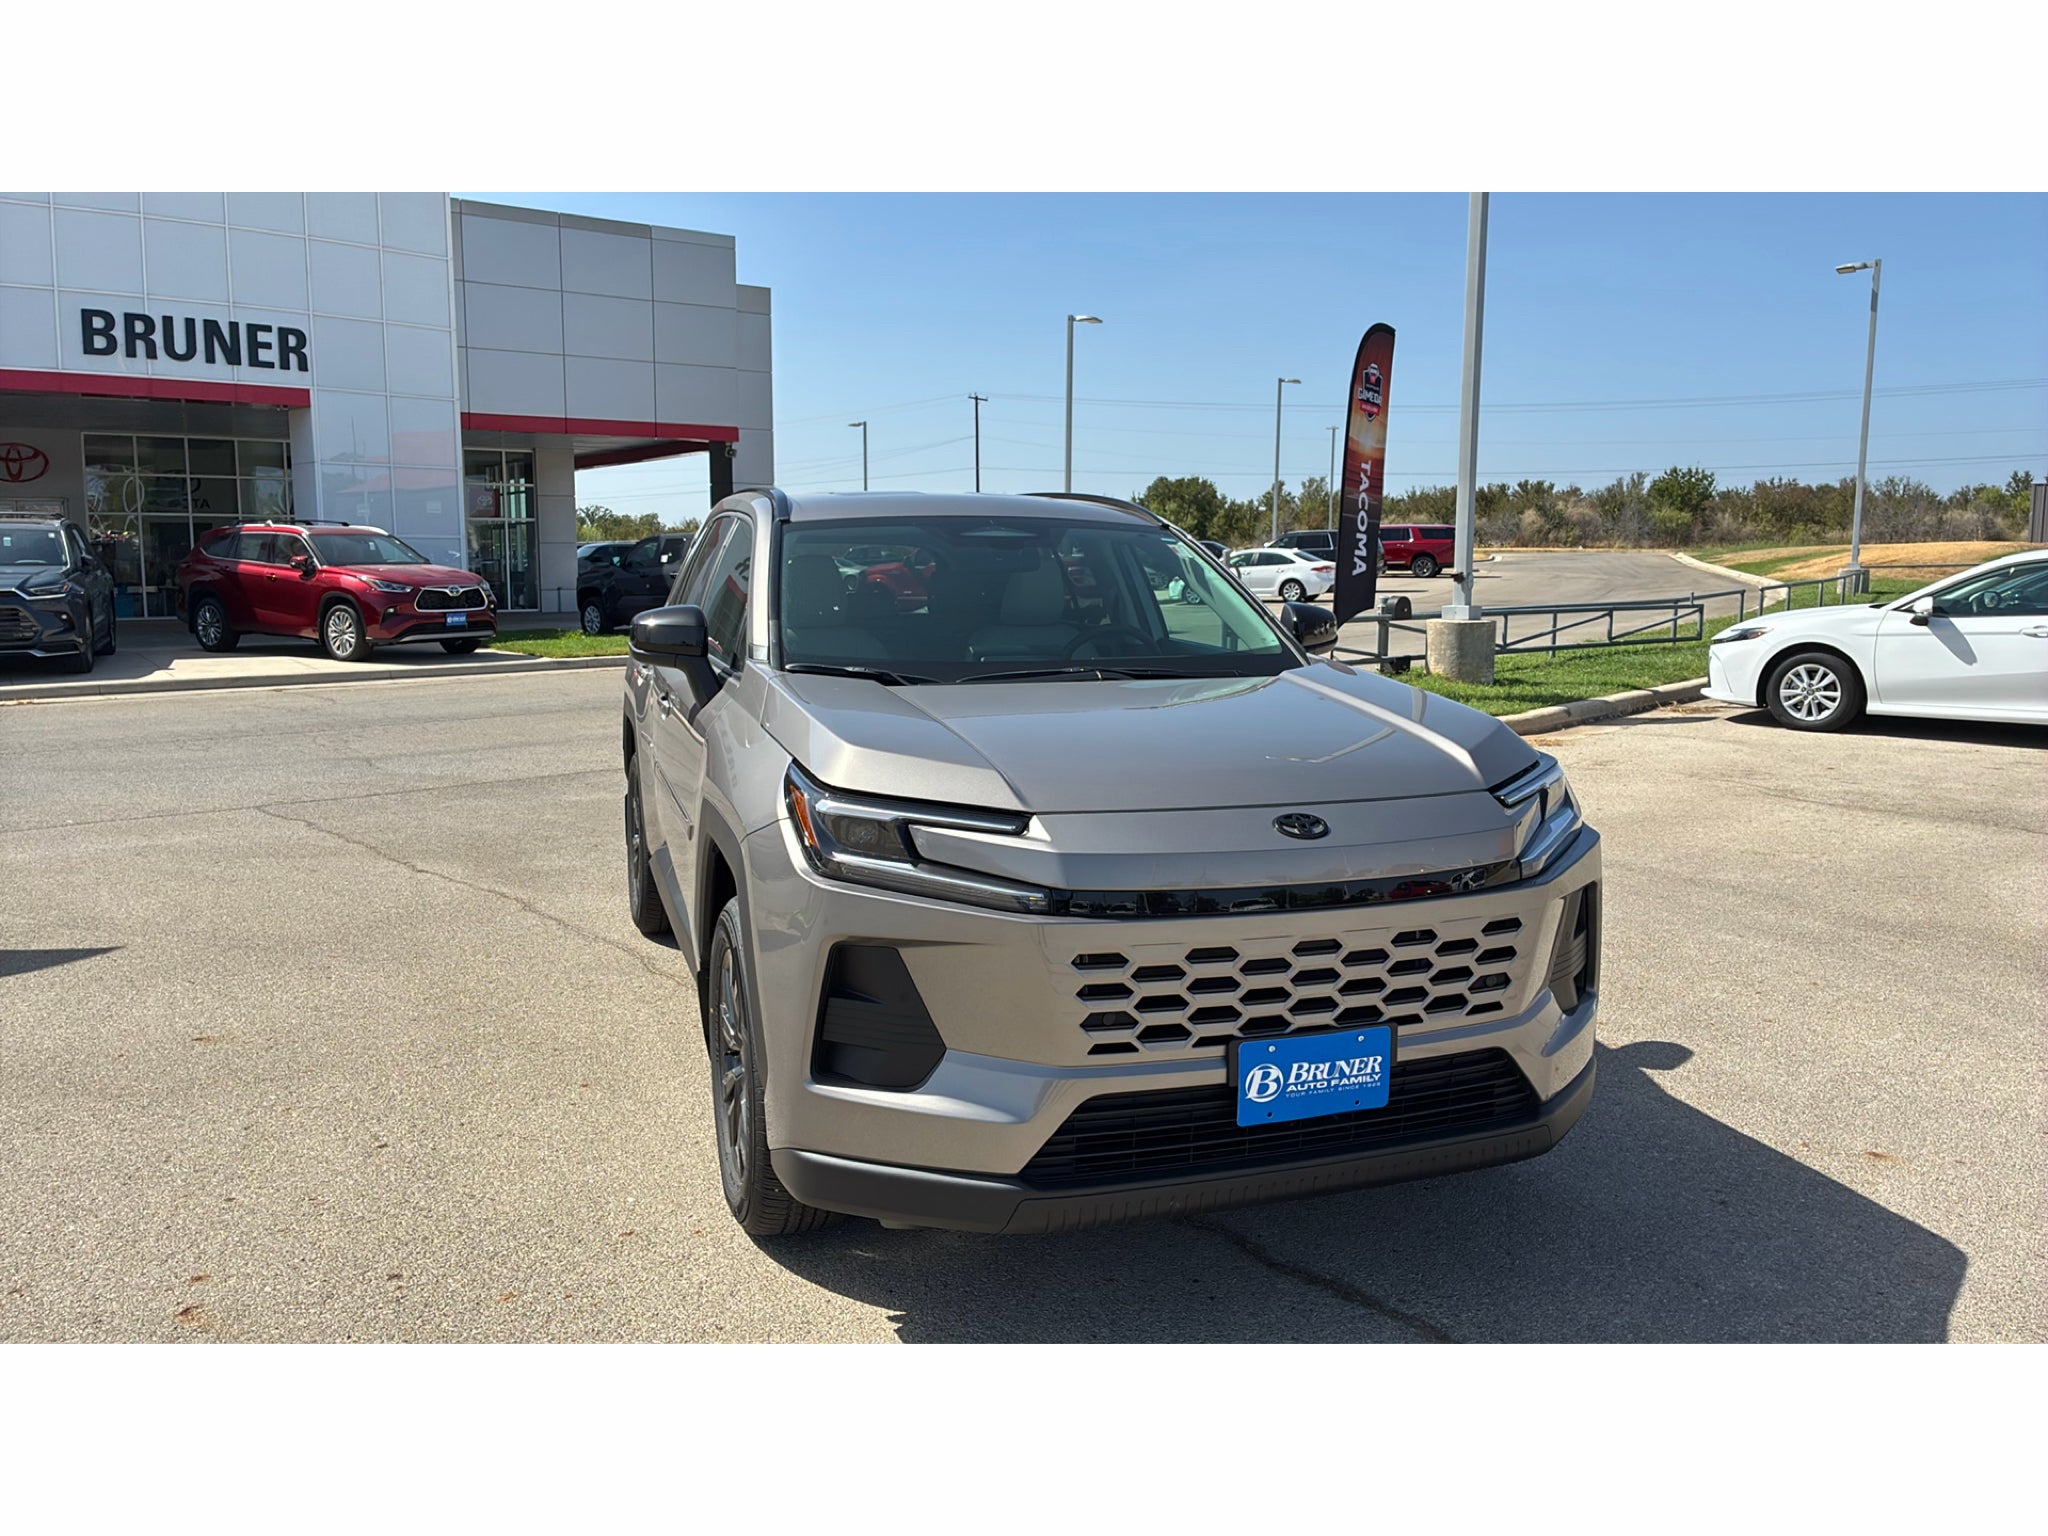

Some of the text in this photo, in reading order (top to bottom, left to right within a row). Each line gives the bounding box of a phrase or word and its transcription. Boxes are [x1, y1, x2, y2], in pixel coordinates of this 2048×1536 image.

[81, 308, 309, 372] BRUNER
[1352, 460, 1372, 576] TACOMA
[1286, 1055, 1382, 1084] BRUNER
[1286, 1073, 1382, 1093] AUTO FAMILY
[1285, 1091, 1306, 1099] YOUR
[1308, 1087, 1335, 1096] FAMILY
[1338, 1083, 1360, 1091] SINCE
